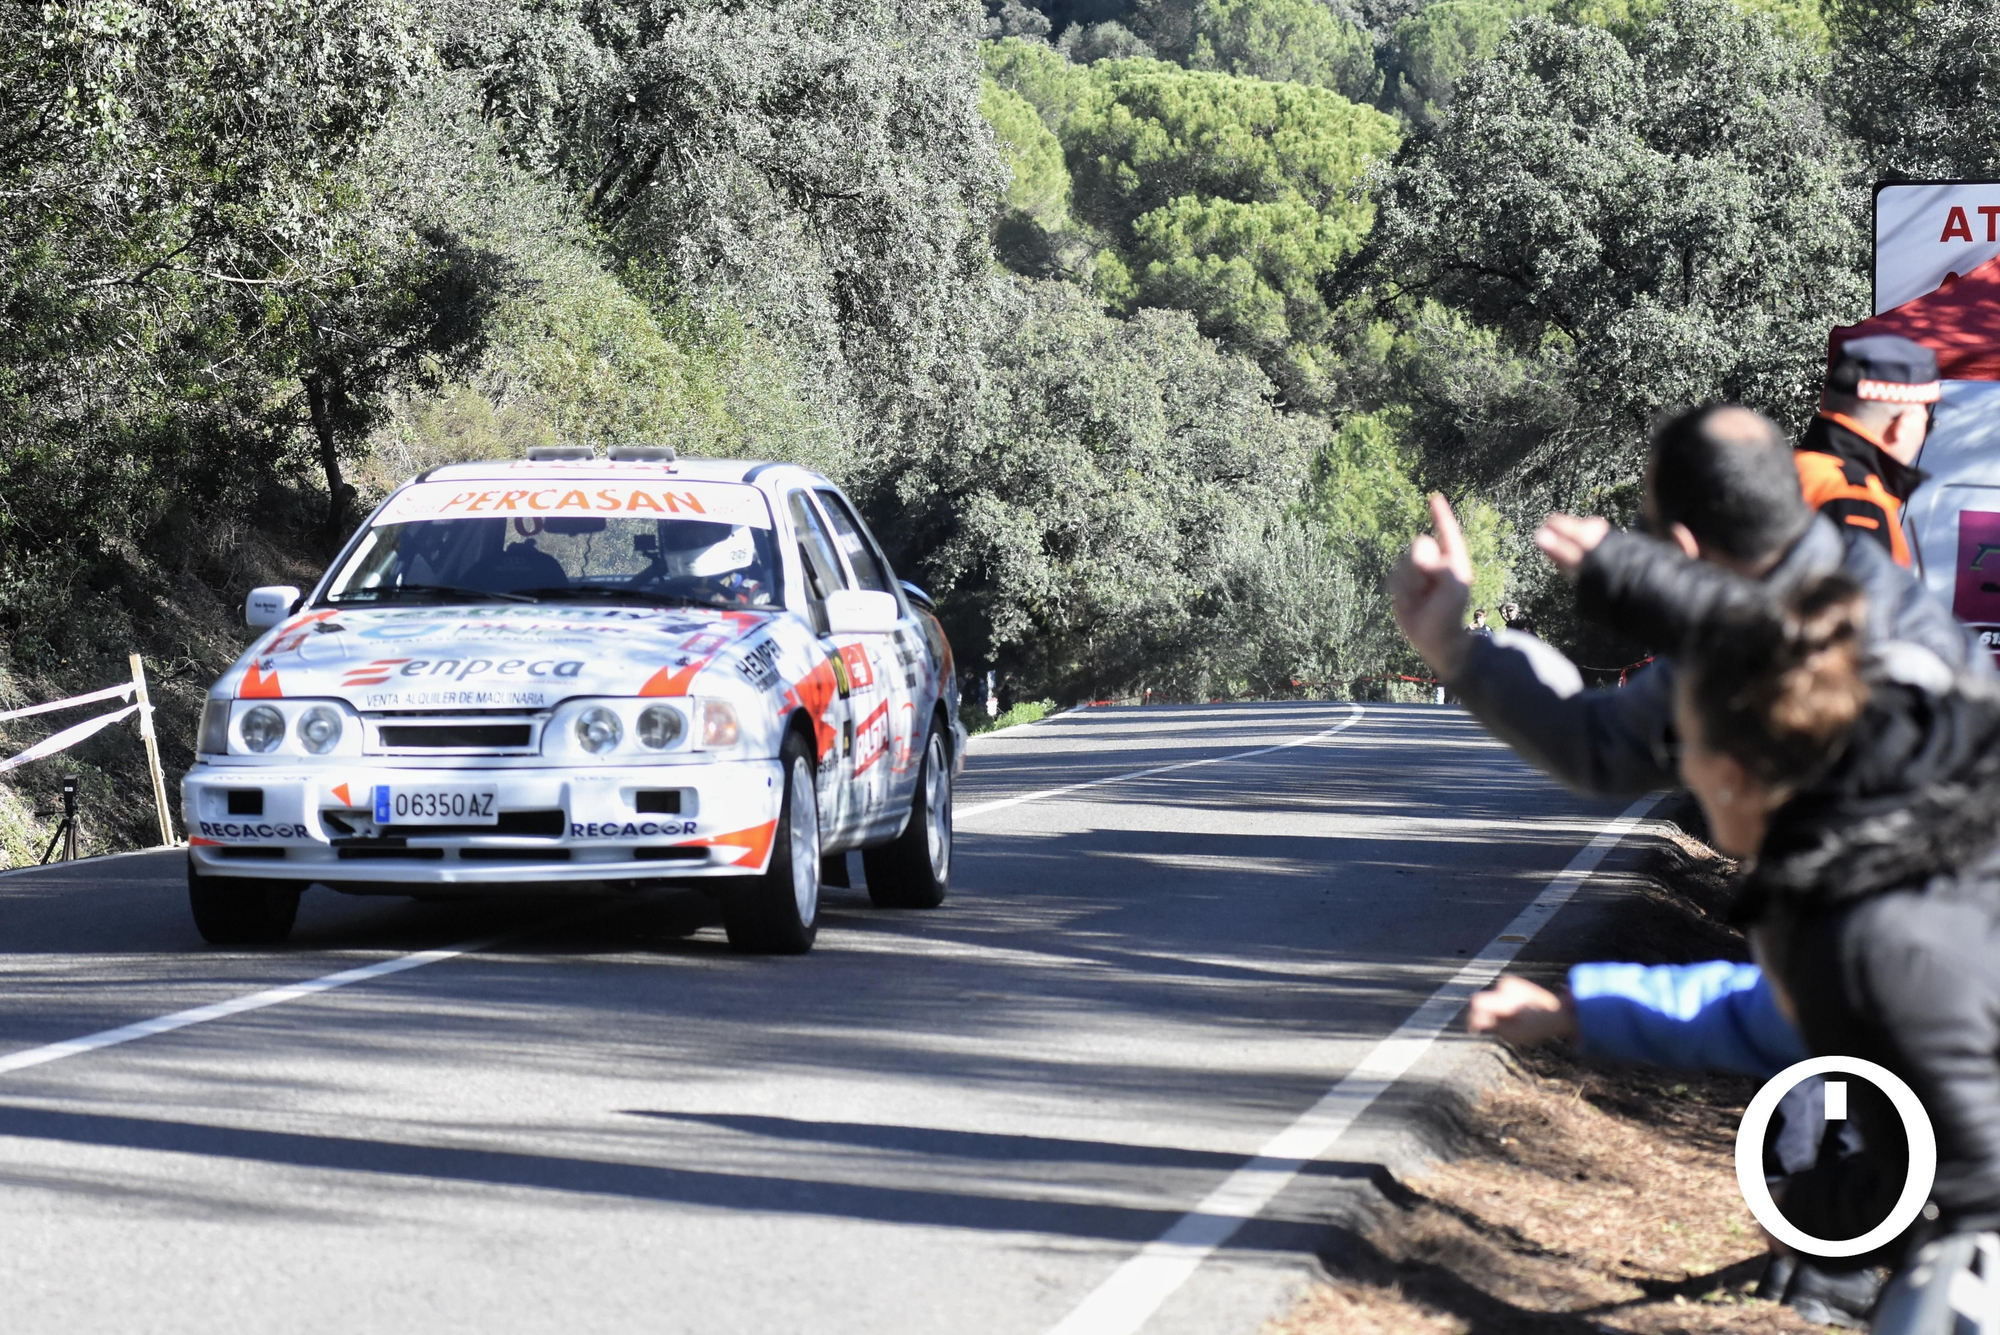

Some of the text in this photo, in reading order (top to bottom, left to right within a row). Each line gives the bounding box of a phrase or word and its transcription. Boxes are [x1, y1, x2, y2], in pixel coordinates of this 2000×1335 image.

[1940, 205, 2000, 243] AT
[439, 488, 707, 515] PERCASAN
[1978, 630, 2000, 646] 61
[367, 691, 545, 707] VENTA ALQUILER DE MAQUINARIA
[200, 821, 310, 839] RECACOR
[571, 821, 698, 838] RECACOR
